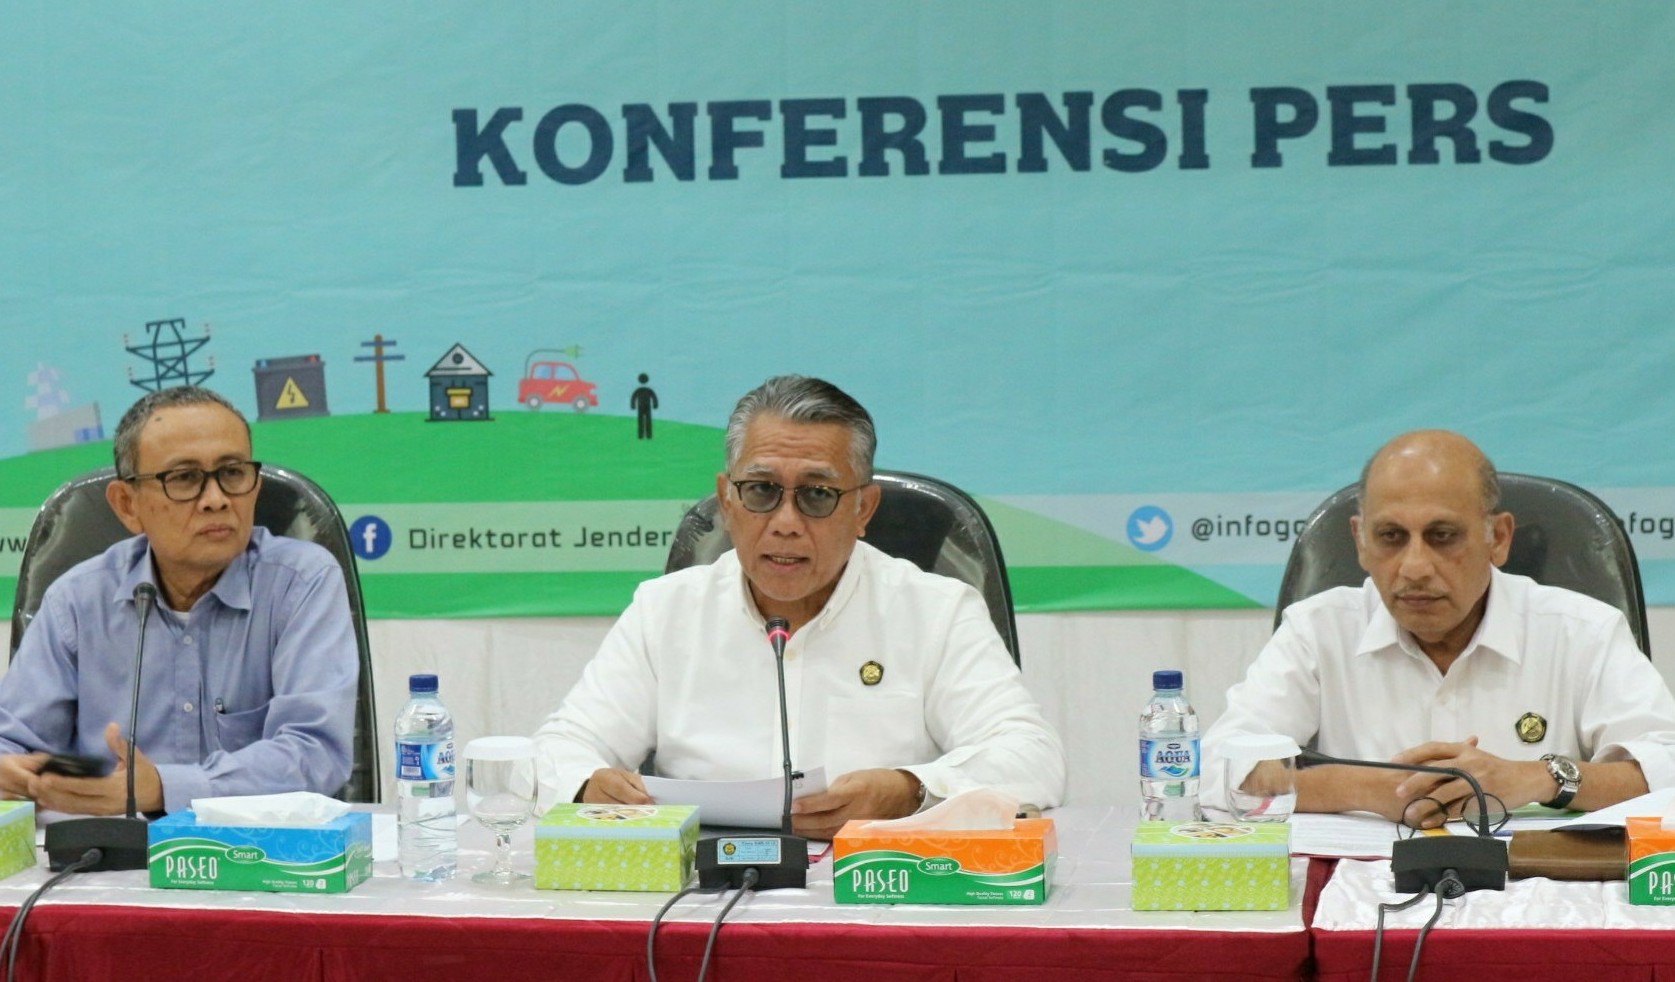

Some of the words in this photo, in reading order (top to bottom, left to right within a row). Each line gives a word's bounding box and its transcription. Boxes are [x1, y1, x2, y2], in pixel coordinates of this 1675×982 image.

[452, 88, 1210, 187] KONFERENSI
[1249, 80, 1554, 168] PERS
[409, 527, 562, 549] Direktorat
[574, 525, 672, 548] Jender
[1155, 750, 1191, 765] AQUA
[233, 850, 258, 859] Smart
[925, 861, 953, 871] Smart
[166, 855, 218, 880] PASEO
[853, 869, 909, 893] PASEO
